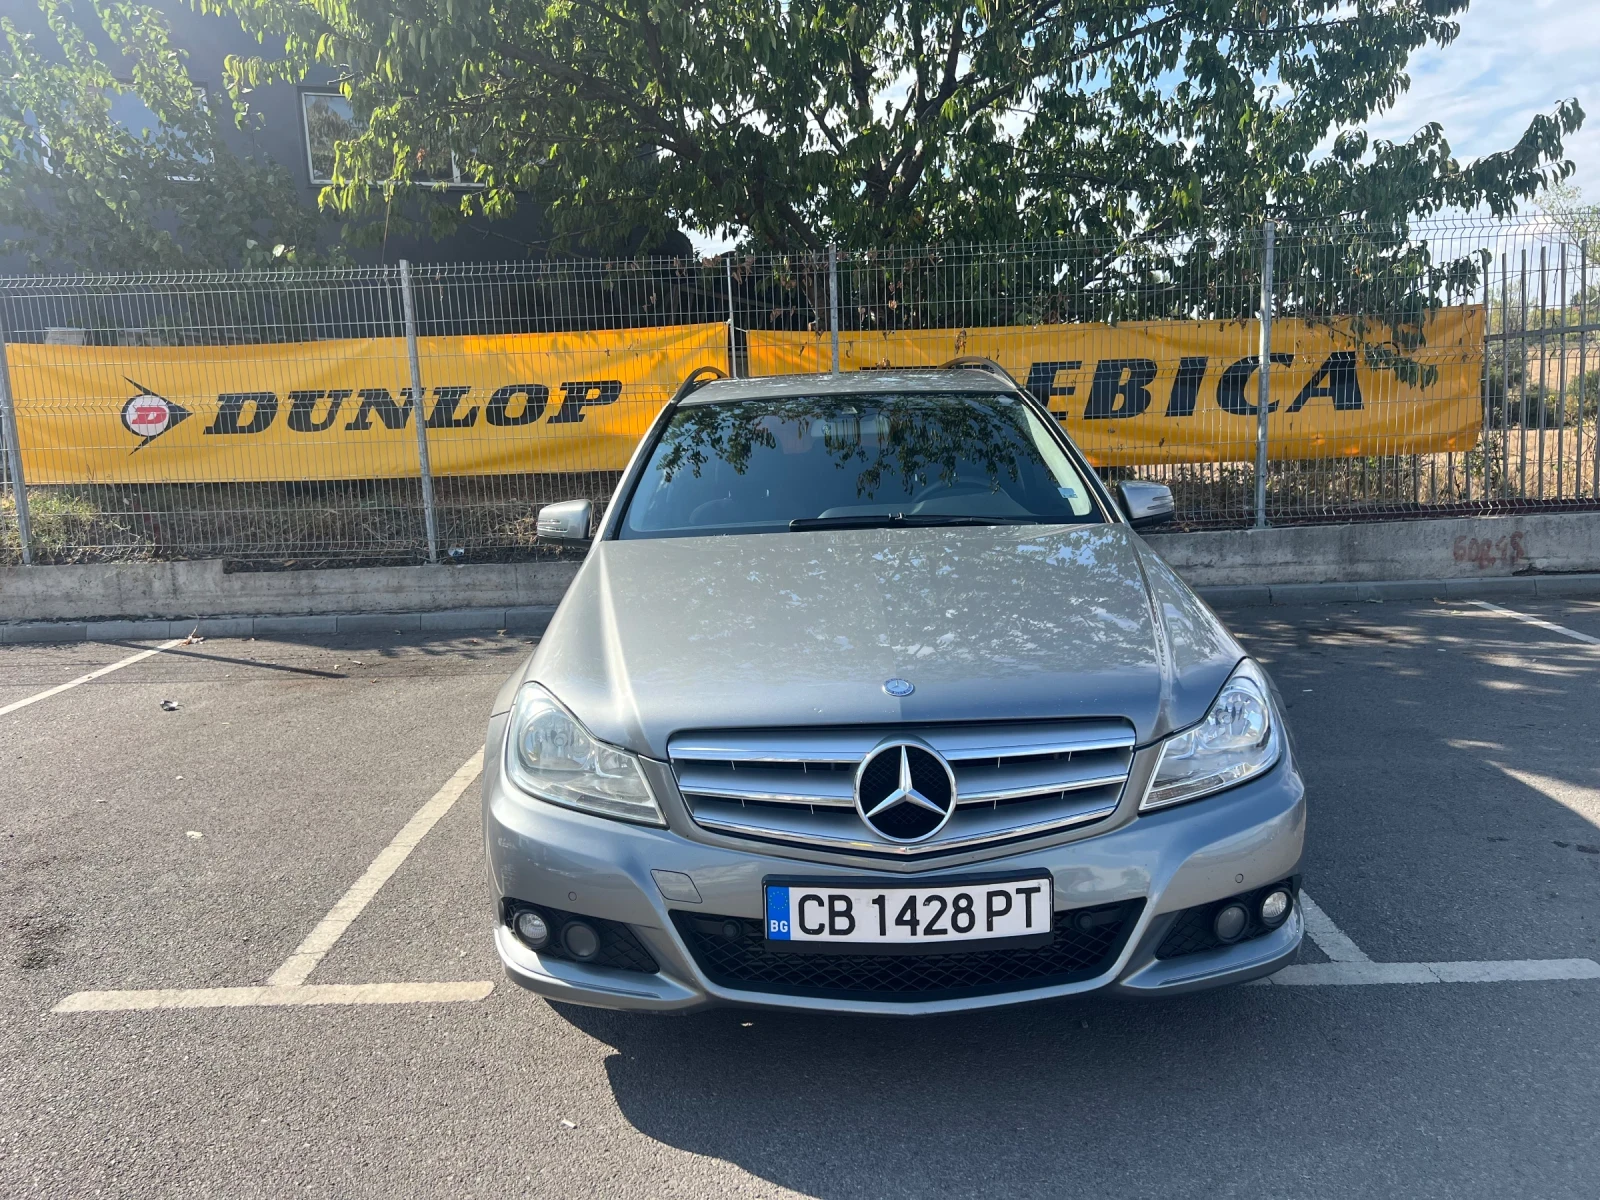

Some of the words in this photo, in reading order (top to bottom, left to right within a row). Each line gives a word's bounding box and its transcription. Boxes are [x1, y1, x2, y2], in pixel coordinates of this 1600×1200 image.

[203, 379, 623, 435] DUNLOP
[860, 351, 1365, 421] EBICA
[131, 406, 169, 425] D
[770, 920, 789, 933] BG
[798, 894, 856, 936] CB
[871, 893, 976, 936] 1428
[986, 886, 1041, 932] PT
